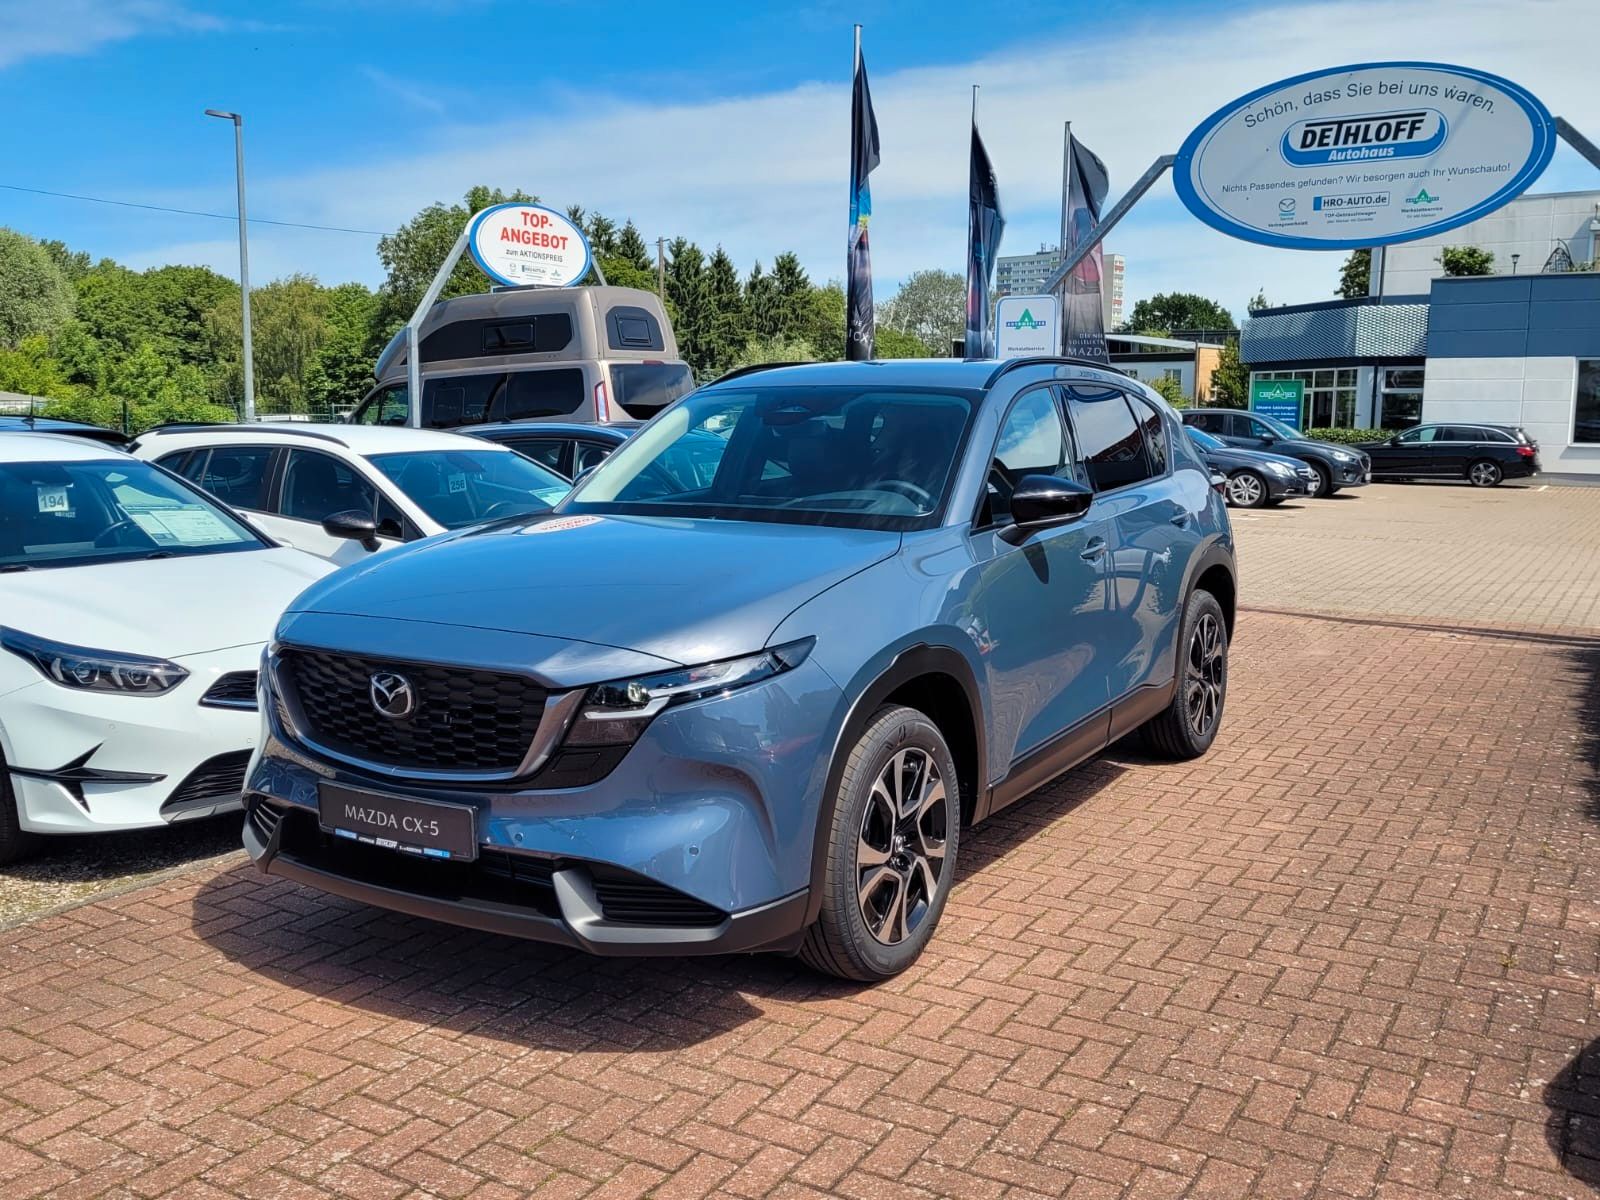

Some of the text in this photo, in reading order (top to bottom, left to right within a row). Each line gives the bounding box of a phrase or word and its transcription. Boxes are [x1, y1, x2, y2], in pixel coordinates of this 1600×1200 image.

[1244, 80, 1494, 128] Schön, dass Sie bei uns waren.
[1300, 112, 1427, 149] DETHLOFF
[1327, 146, 1395, 161] Autohaus
[1221, 162, 1511, 193] Nichts Passendes gefunden? Wir besorgen auch Ihr Wunschauto!
[1322, 194, 1387, 208] HRO-AUTO.de
[520, 211, 553, 229] TOP-
[500, 226, 568, 250] ANGEBOT
[505, 248, 563, 263] zum AKTIONSPREIS
[40, 495, 65, 508] 194
[344, 804, 440, 837] MAZDA CX-5
